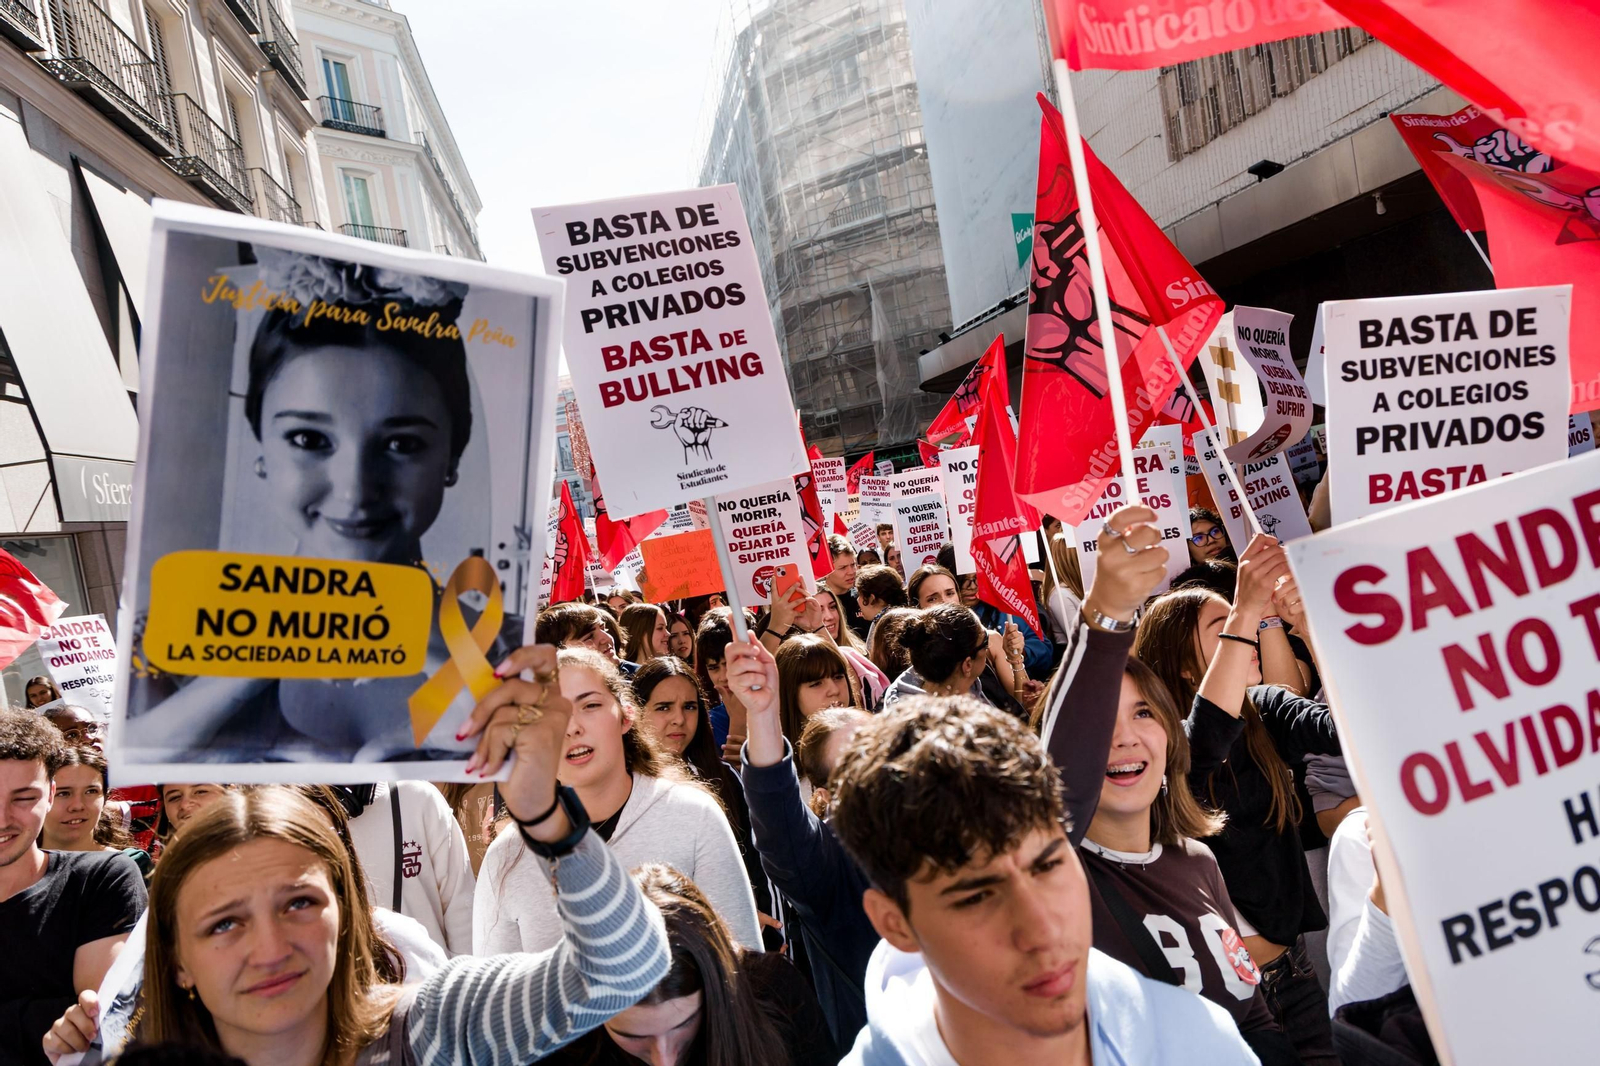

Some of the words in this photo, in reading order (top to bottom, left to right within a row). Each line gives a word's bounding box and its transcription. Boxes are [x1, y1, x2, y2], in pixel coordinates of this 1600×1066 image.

[1401, 114, 1450, 128] Sindicato
[1450, 114, 1469, 127] de
[565, 210, 671, 246] BASTA
[675, 203, 719, 229] DE
[556, 230, 741, 274] SUBVENCIONES
[591, 279, 608, 298] A
[611, 259, 724, 293] COLEGIOS
[202, 275, 301, 312] Justicia
[304, 301, 373, 327] para
[376, 302, 460, 340] Sandra
[467, 318, 518, 349] Peña
[580, 282, 746, 334] PRIVADOS
[1237, 325, 1251, 341] NO
[1253, 328, 1286, 346] QUERÍA
[1359, 312, 1479, 349] BASTA
[1489, 307, 1537, 339] DE
[601, 328, 713, 372] BASTA
[719, 329, 748, 349] DE
[1249, 346, 1285, 365] MORIR,
[1261, 365, 1296, 381] QUERÍA
[1341, 345, 1556, 382] SUBVENCIONES
[598, 352, 764, 409] BULLYING
[1267, 380, 1294, 397] DEJAR
[1295, 385, 1308, 399] DE
[1372, 392, 1391, 413] A
[1397, 380, 1529, 410] COLEGIOS
[1276, 400, 1305, 418] SUFRIR
[1356, 411, 1545, 456] PRIVADOS
[676, 465, 715, 481] Sindicato
[715, 463, 726, 472] de
[948, 461, 968, 473] NO
[680, 472, 729, 490] Estudiantes
[815, 475, 844, 483] VIDAMOS
[893, 481, 906, 489] NO
[908, 474, 940, 487] QUERÍA
[1228, 477, 1270, 502] BSTA
[1271, 475, 1282, 486] DE
[1368, 464, 1487, 504] BASTA
[901, 485, 933, 496] MORIR,
[717, 500, 736, 512] NO
[739, 490, 791, 508] QUERÍA
[897, 507, 911, 515] NO
[911, 500, 942, 513] QUERÍA
[731, 507, 782, 524] MORIR,
[908, 512, 938, 523] MORIR,
[732, 520, 786, 539] QUERÍA
[909, 521, 940, 535] QUERÍA
[728, 537, 773, 553] DEJAR
[776, 533, 796, 545] DE
[906, 534, 932, 545] DEJAR
[934, 532, 944, 540] DE
[912, 542, 942, 554] SUFRIR
[738, 547, 790, 564] SUFRIR
[218, 562, 377, 598] SANDRA
[975, 550, 988, 568] de
[985, 565, 1039, 632] Estudiantes
[195, 608, 257, 637] NO
[267, 605, 390, 641] MURIÓ
[58, 638, 82, 652] NO
[82, 636, 100, 648] TE
[50, 649, 116, 668] OLVIDAMOS
[167, 644, 195, 661] LA
[201, 645, 311, 662] SOCIEDAD
[316, 648, 342, 664] LA
[347, 644, 406, 665] MATÓ
[83, 664, 100, 674] HAY
[1441, 617, 1562, 713] NO
[61, 673, 115, 691] RESPONSAB
[1400, 689, 1600, 817] OLVID
[1441, 865, 1600, 965] RESPO
